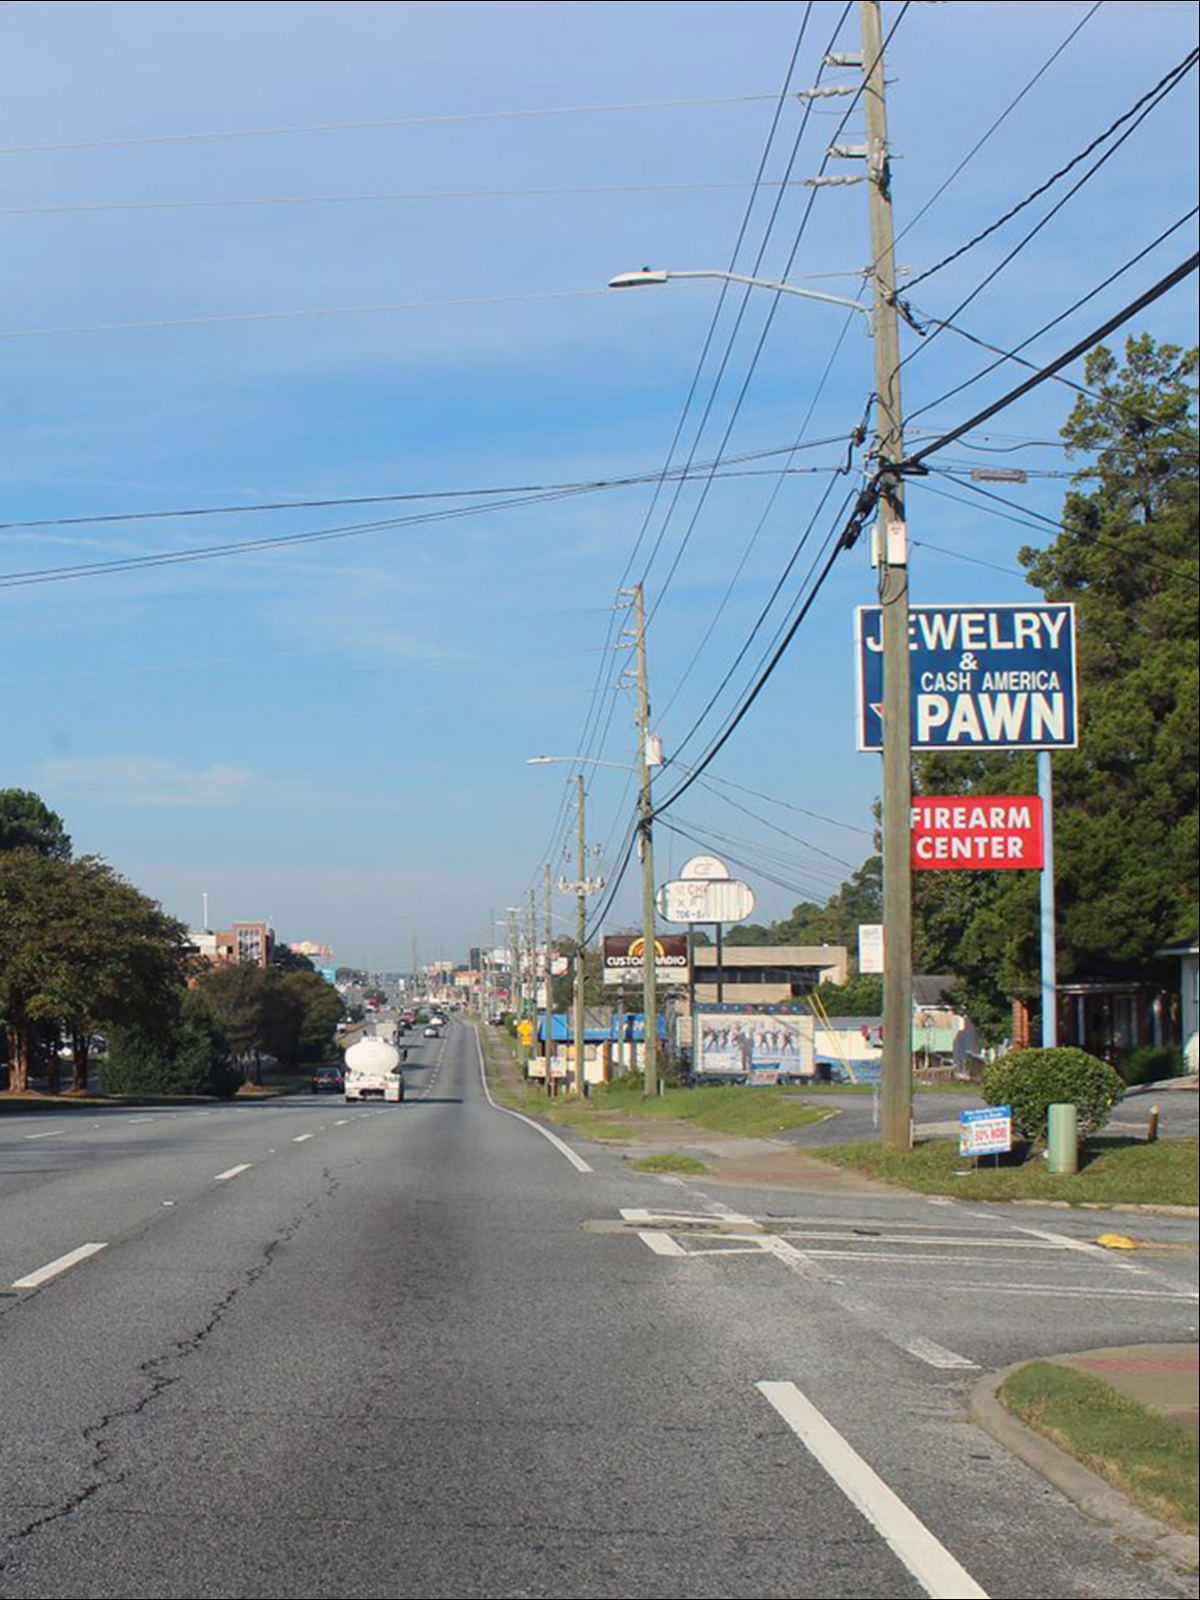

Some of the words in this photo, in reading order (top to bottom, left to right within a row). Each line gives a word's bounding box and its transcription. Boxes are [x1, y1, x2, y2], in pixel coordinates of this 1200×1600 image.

[959, 652, 978, 670] &
[921, 672, 971, 692] CASH
[982, 670, 1060, 691] AMERICA
[917, 693, 1065, 742] PAWN
[909, 806, 1031, 829] FIREARM
[916, 837, 1023, 859] CENTER
